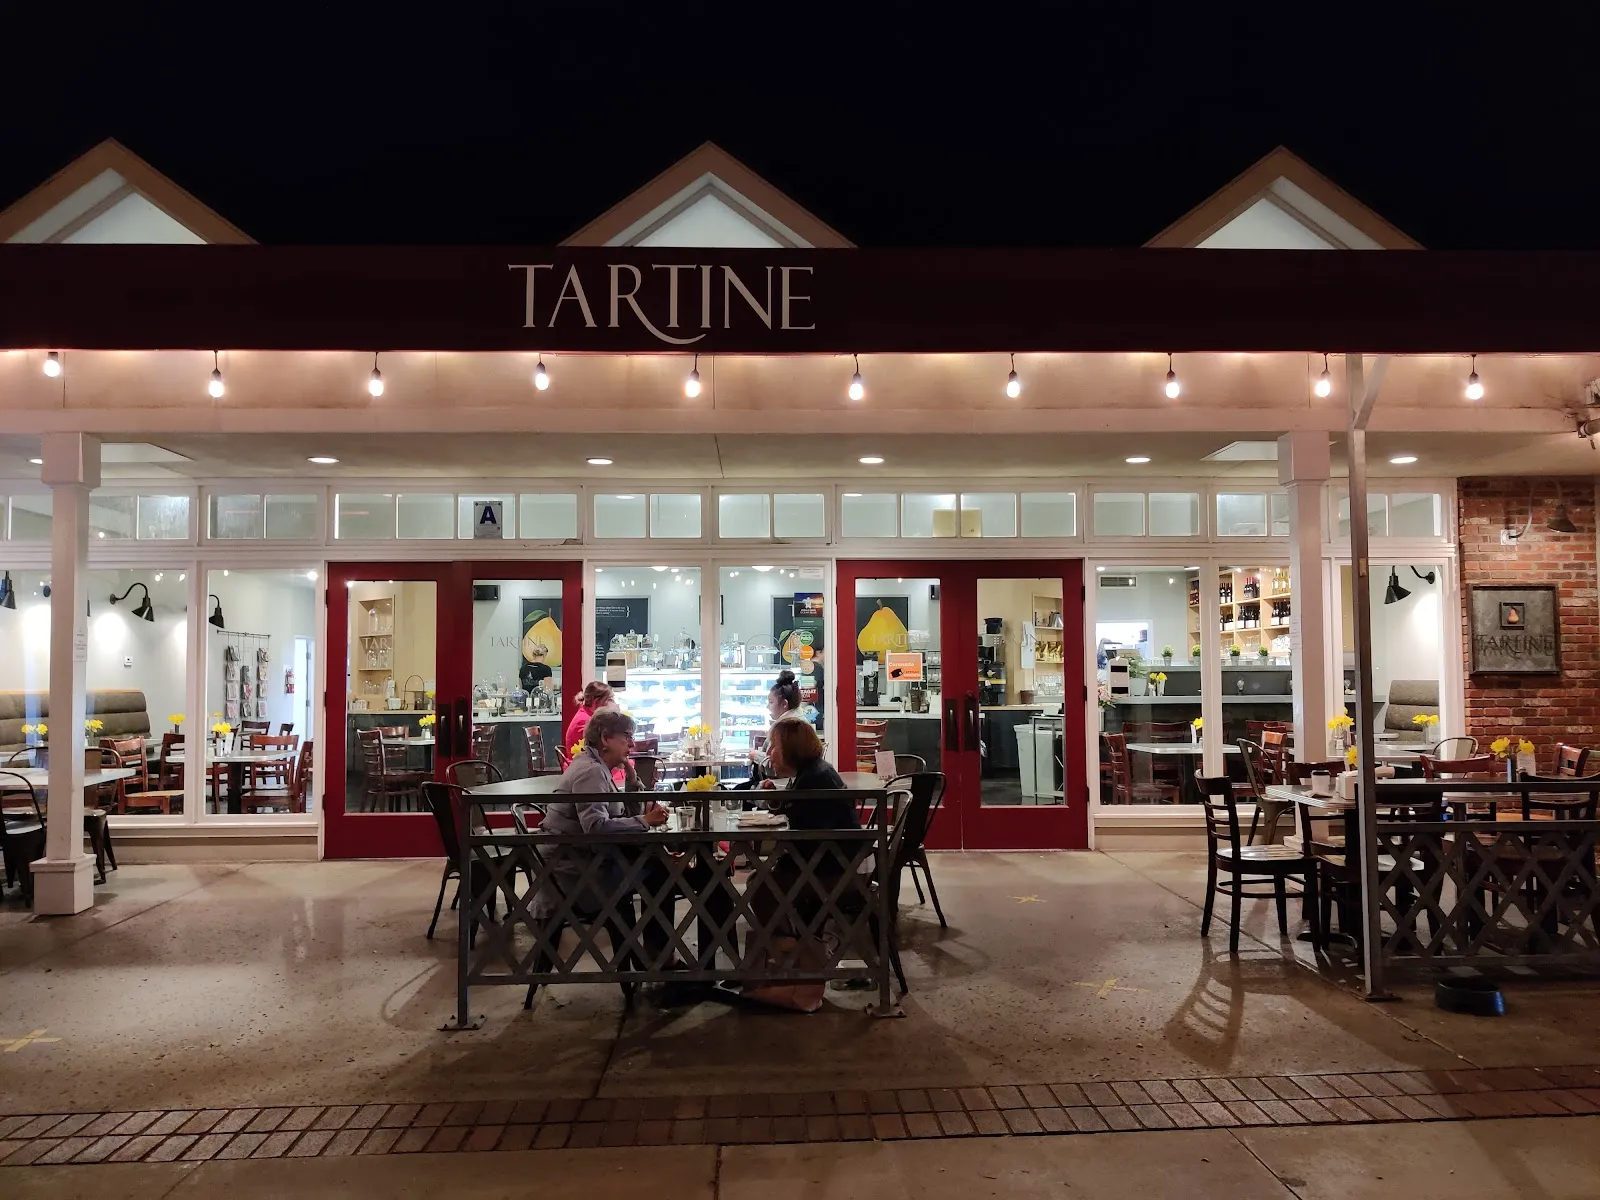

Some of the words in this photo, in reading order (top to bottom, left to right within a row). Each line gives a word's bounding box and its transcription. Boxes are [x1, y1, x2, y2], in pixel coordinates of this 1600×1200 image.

[507, 263, 816, 345] TARTINE
[480, 505, 496, 524] A
[1477, 633, 1555, 657] TARTINE
